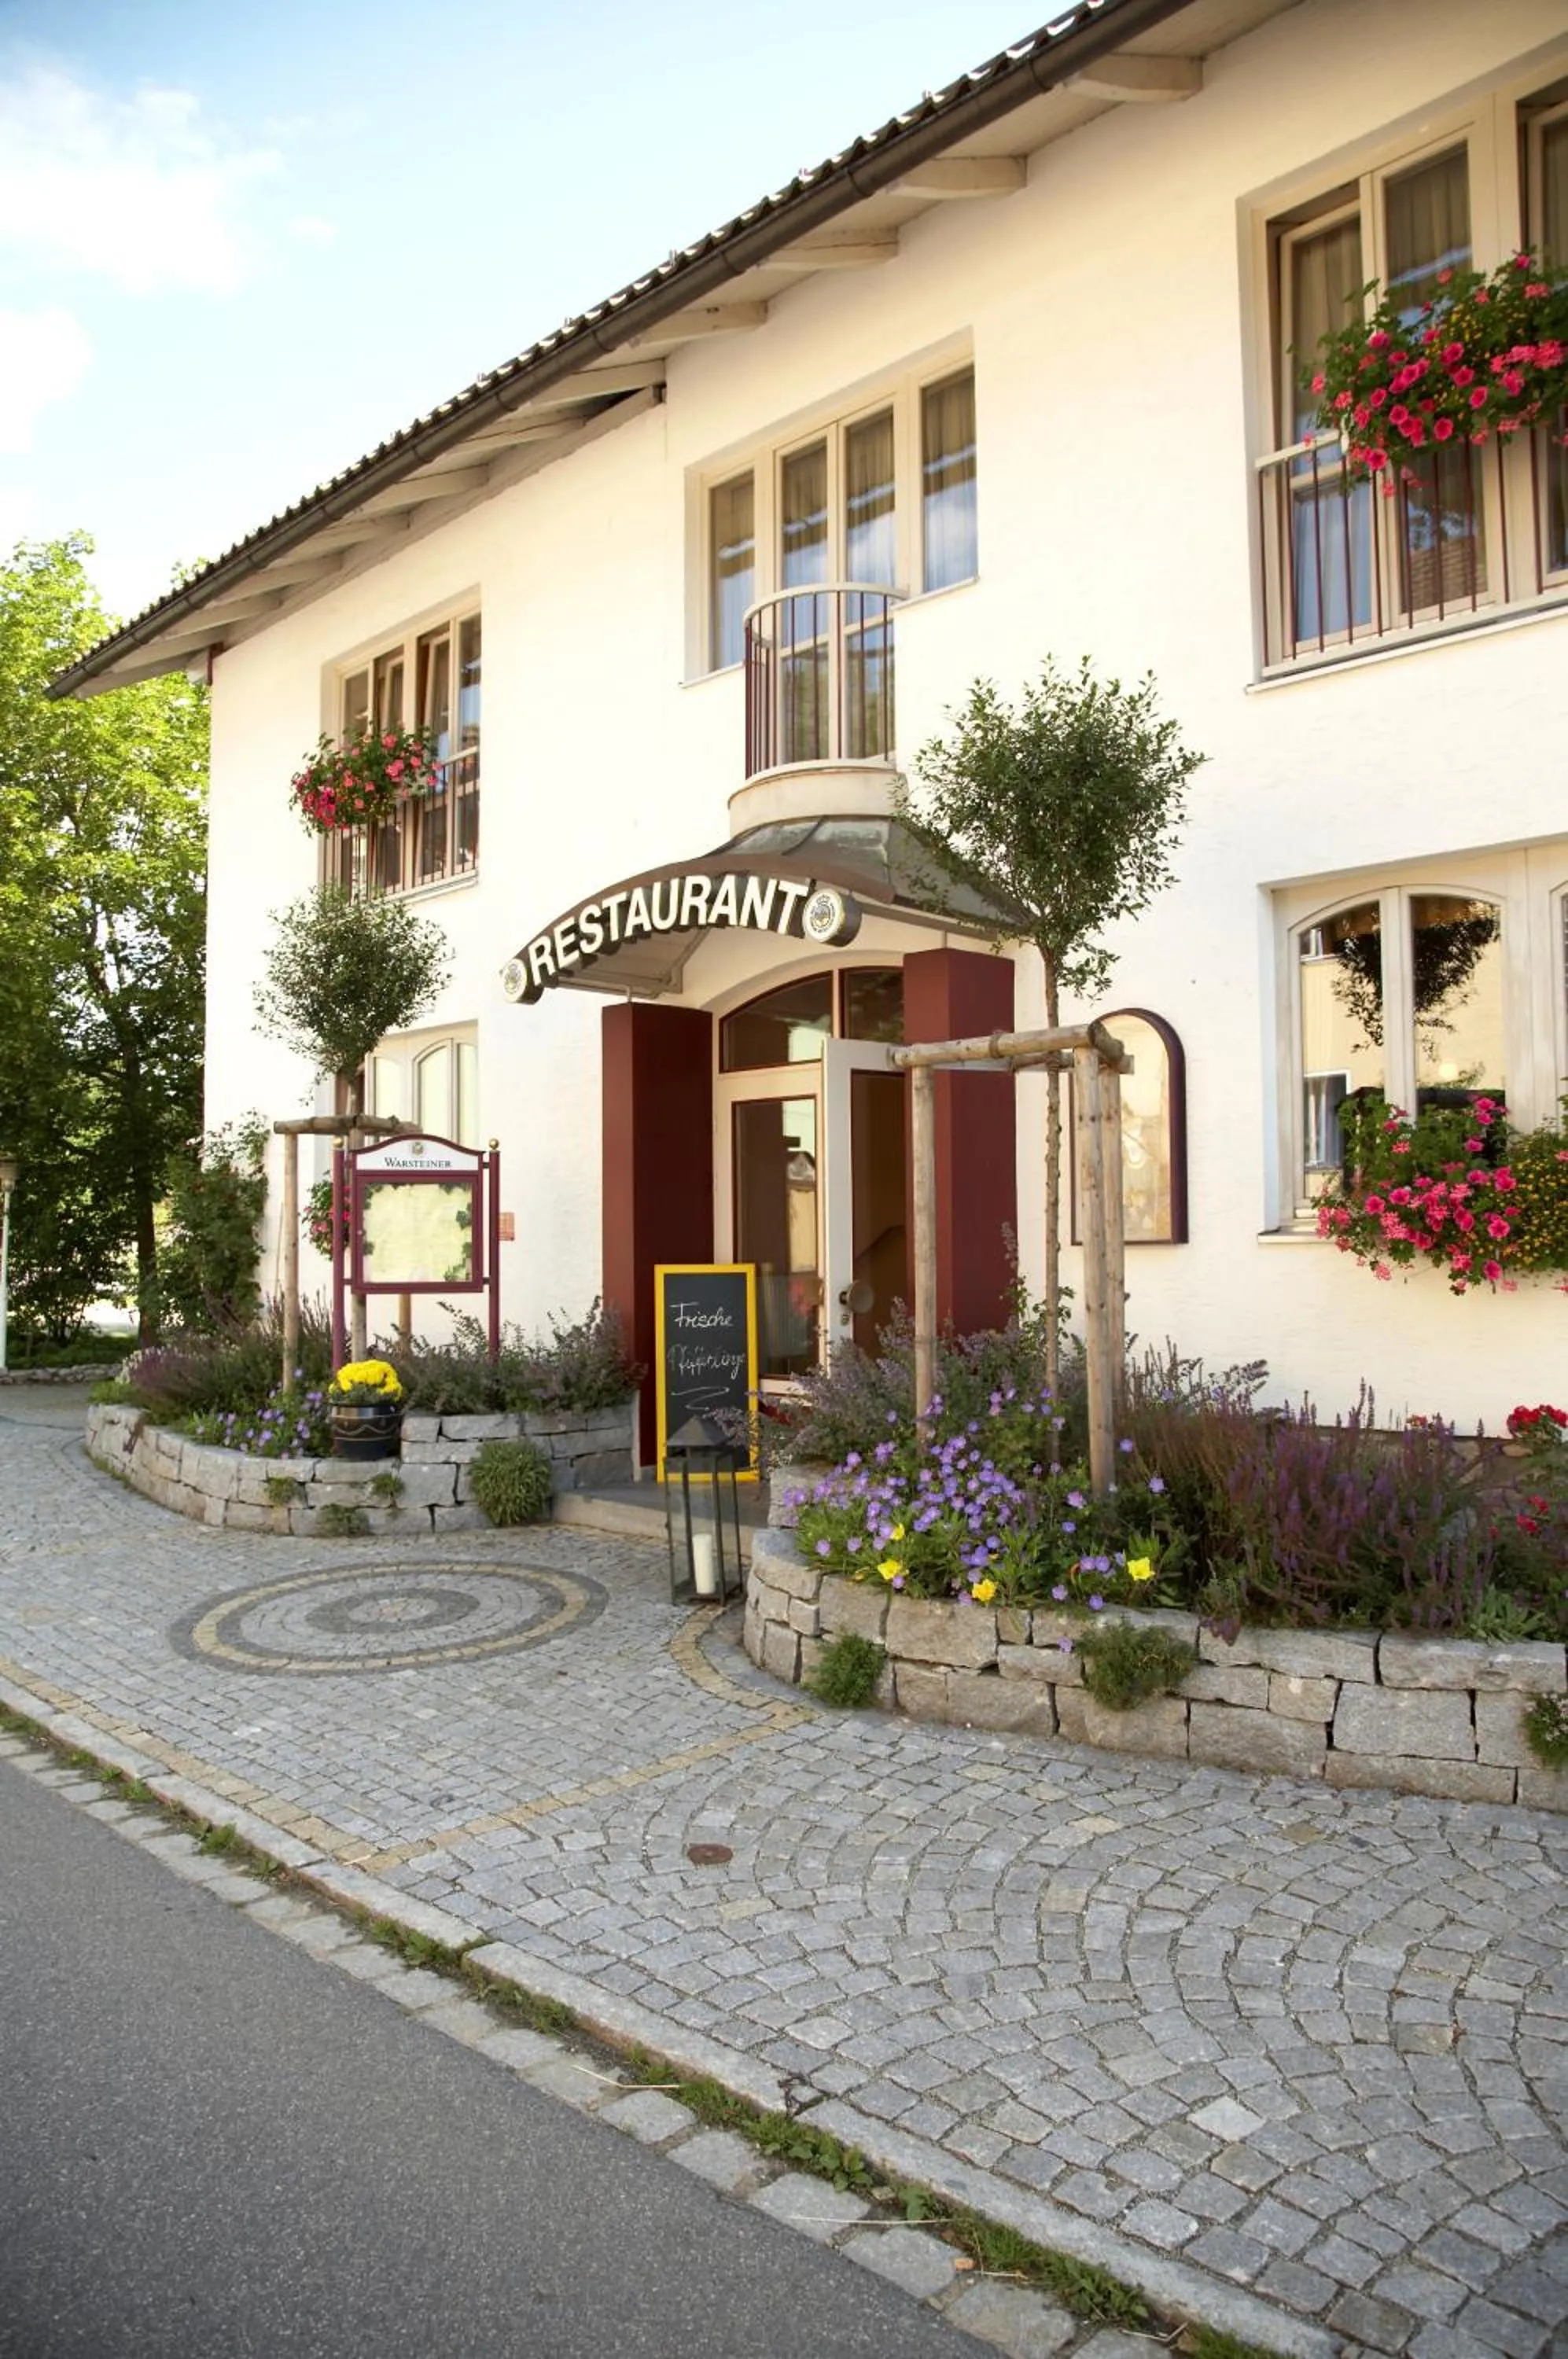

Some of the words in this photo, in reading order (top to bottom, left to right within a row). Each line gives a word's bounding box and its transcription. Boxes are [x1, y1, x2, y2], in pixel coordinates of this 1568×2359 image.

[528, 874, 808, 987] RESTAURANT
[384, 1157, 452, 1168] WARSTEINER
[669, 1301, 734, 1328] Frische
